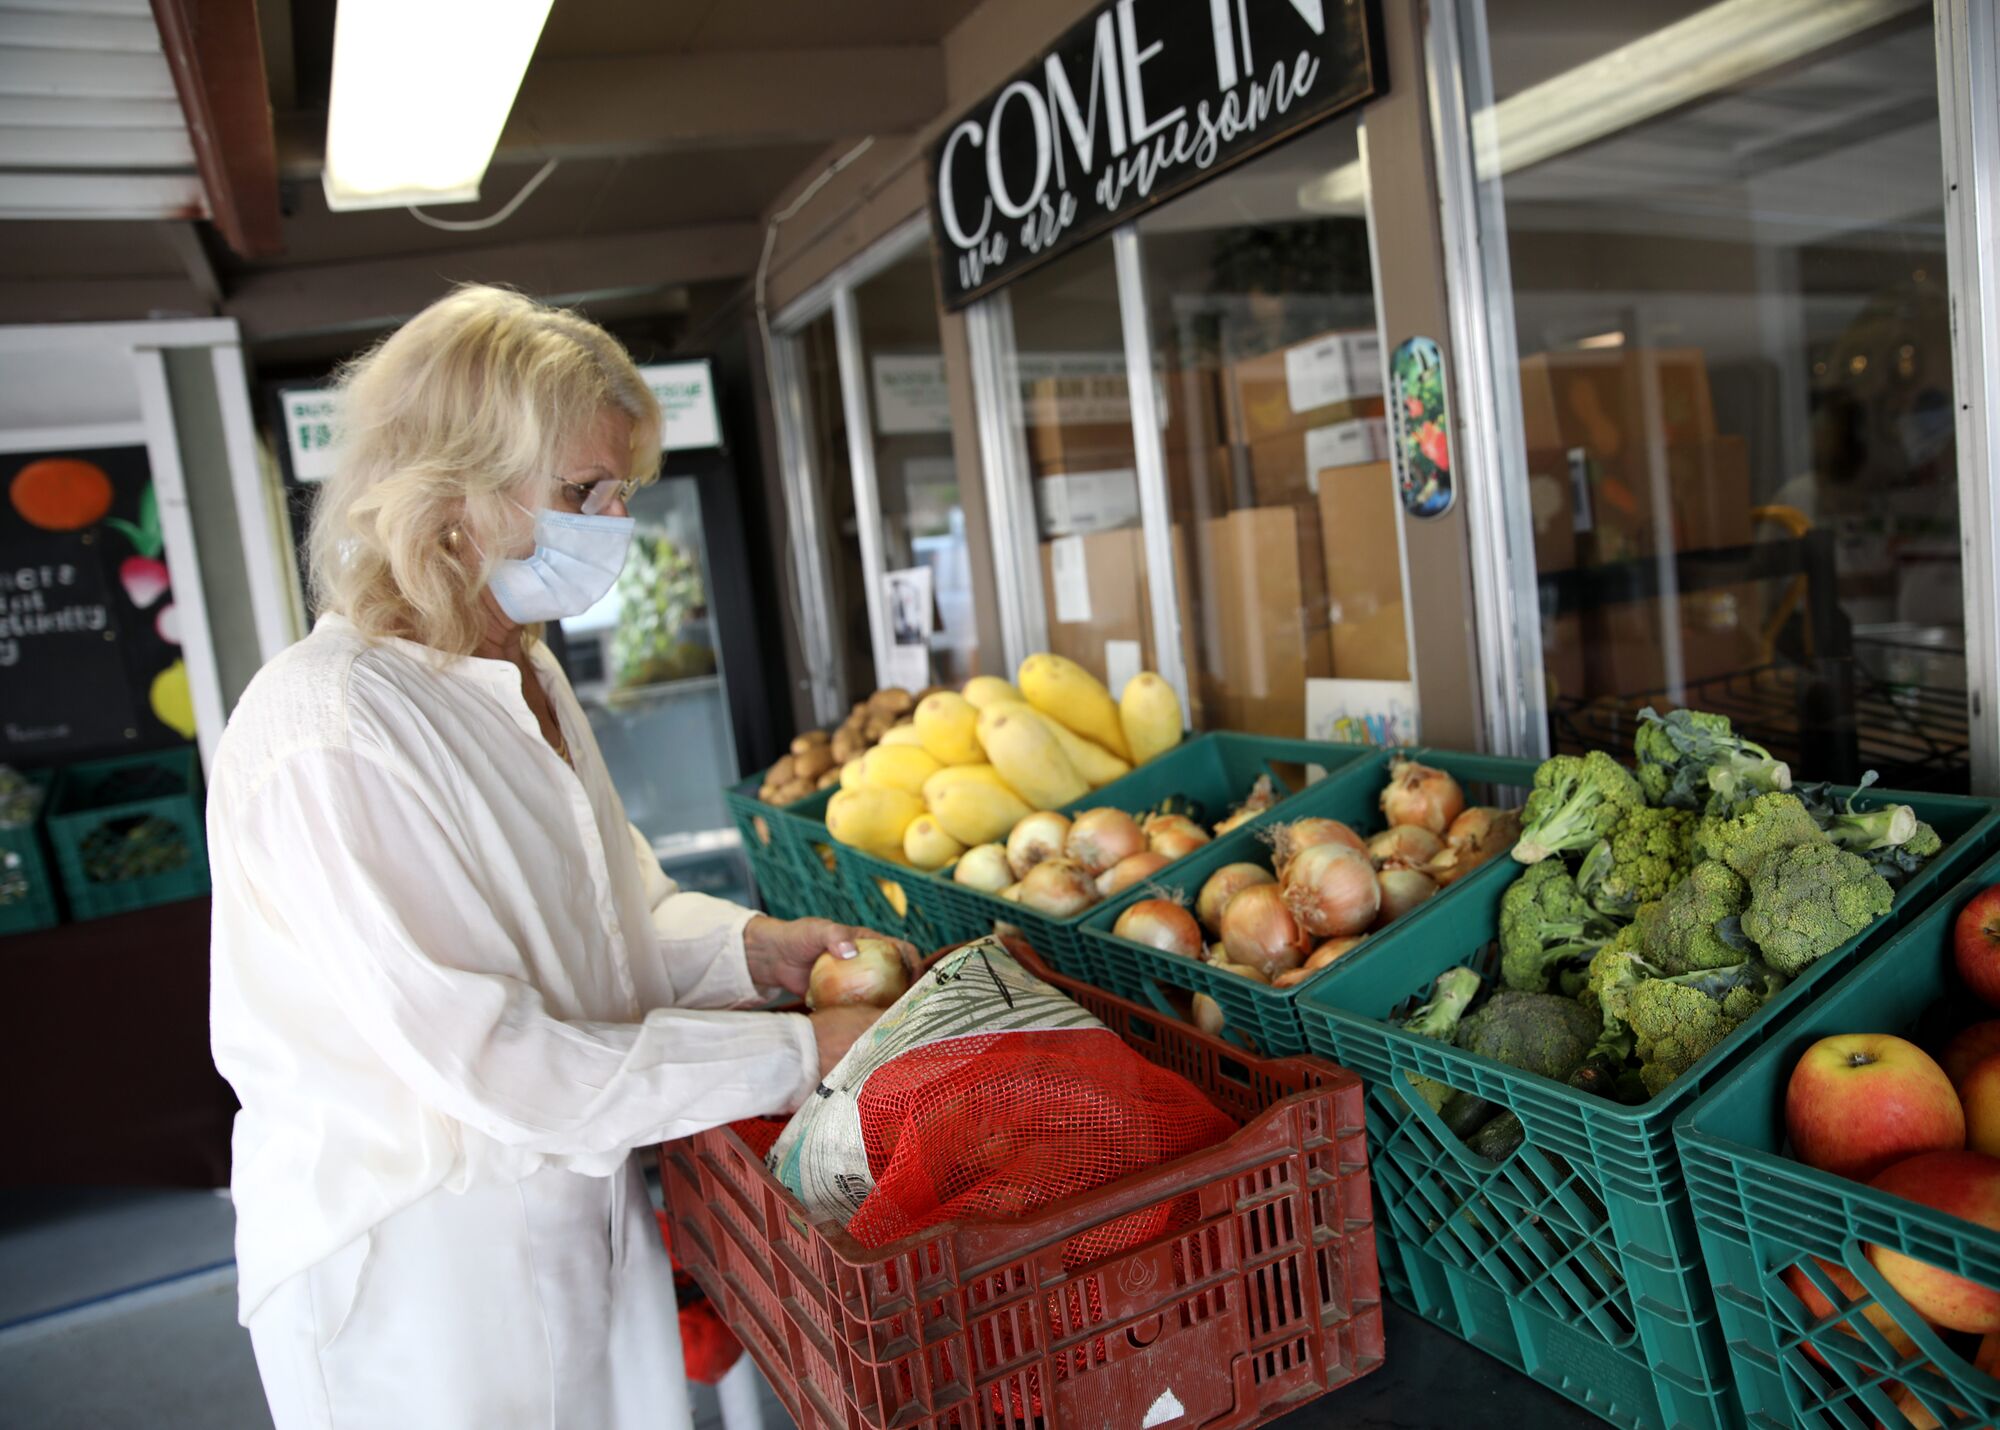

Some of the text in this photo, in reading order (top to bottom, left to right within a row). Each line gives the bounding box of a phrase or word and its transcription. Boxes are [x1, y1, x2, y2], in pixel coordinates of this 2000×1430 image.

[938, 0, 1187, 249] COME
[958, 49, 1320, 290] we are awesome
